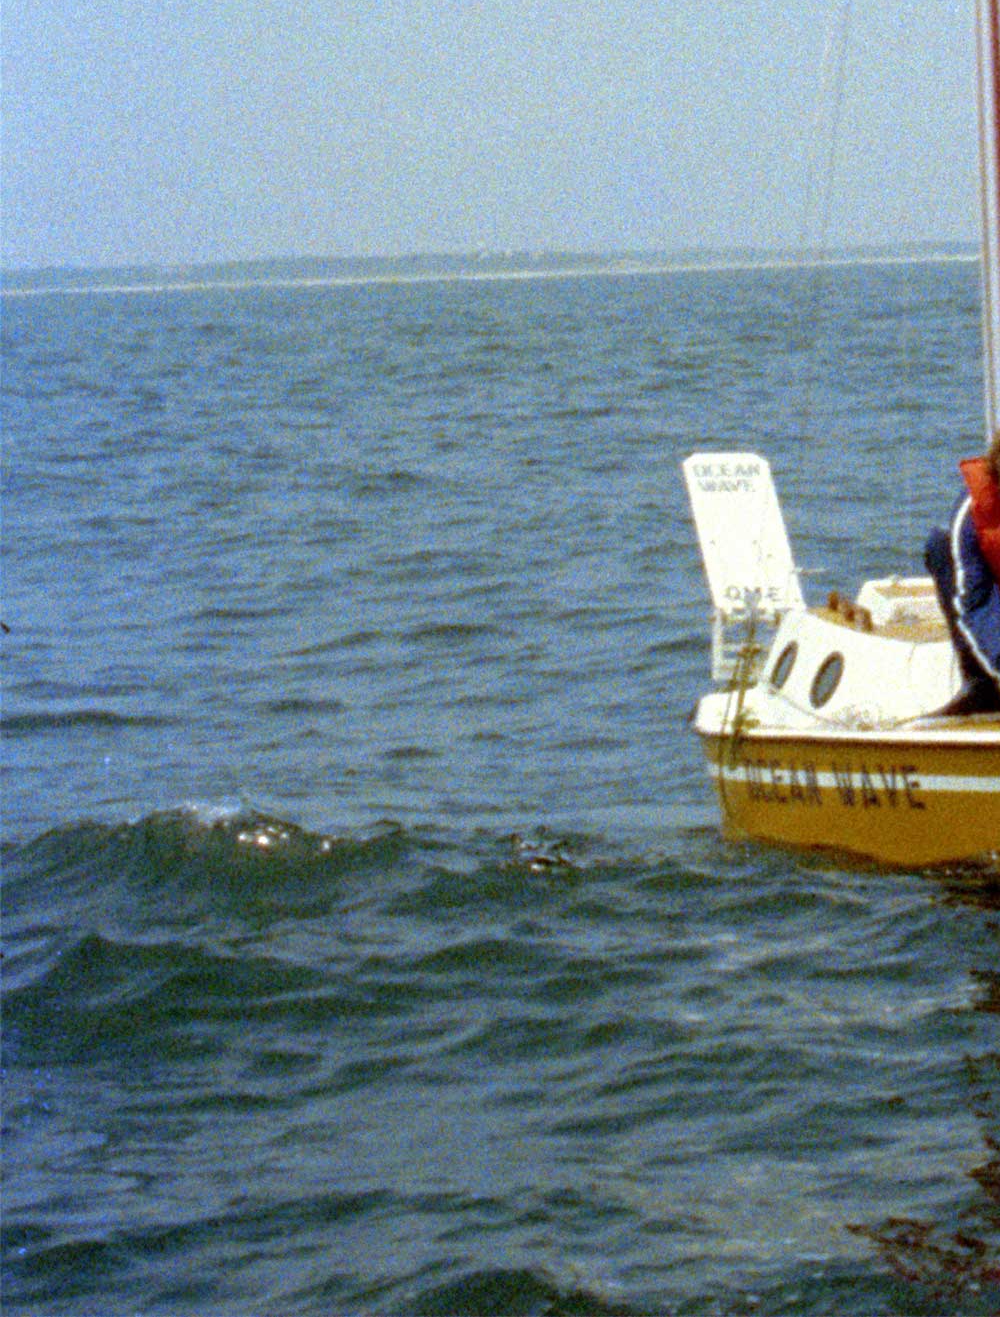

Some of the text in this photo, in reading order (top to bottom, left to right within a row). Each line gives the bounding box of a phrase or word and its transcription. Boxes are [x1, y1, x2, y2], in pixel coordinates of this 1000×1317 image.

[692, 463, 761, 478] OCEAN
[697, 478, 757, 493] WAVE
[832, 761, 926, 809] WAVE
